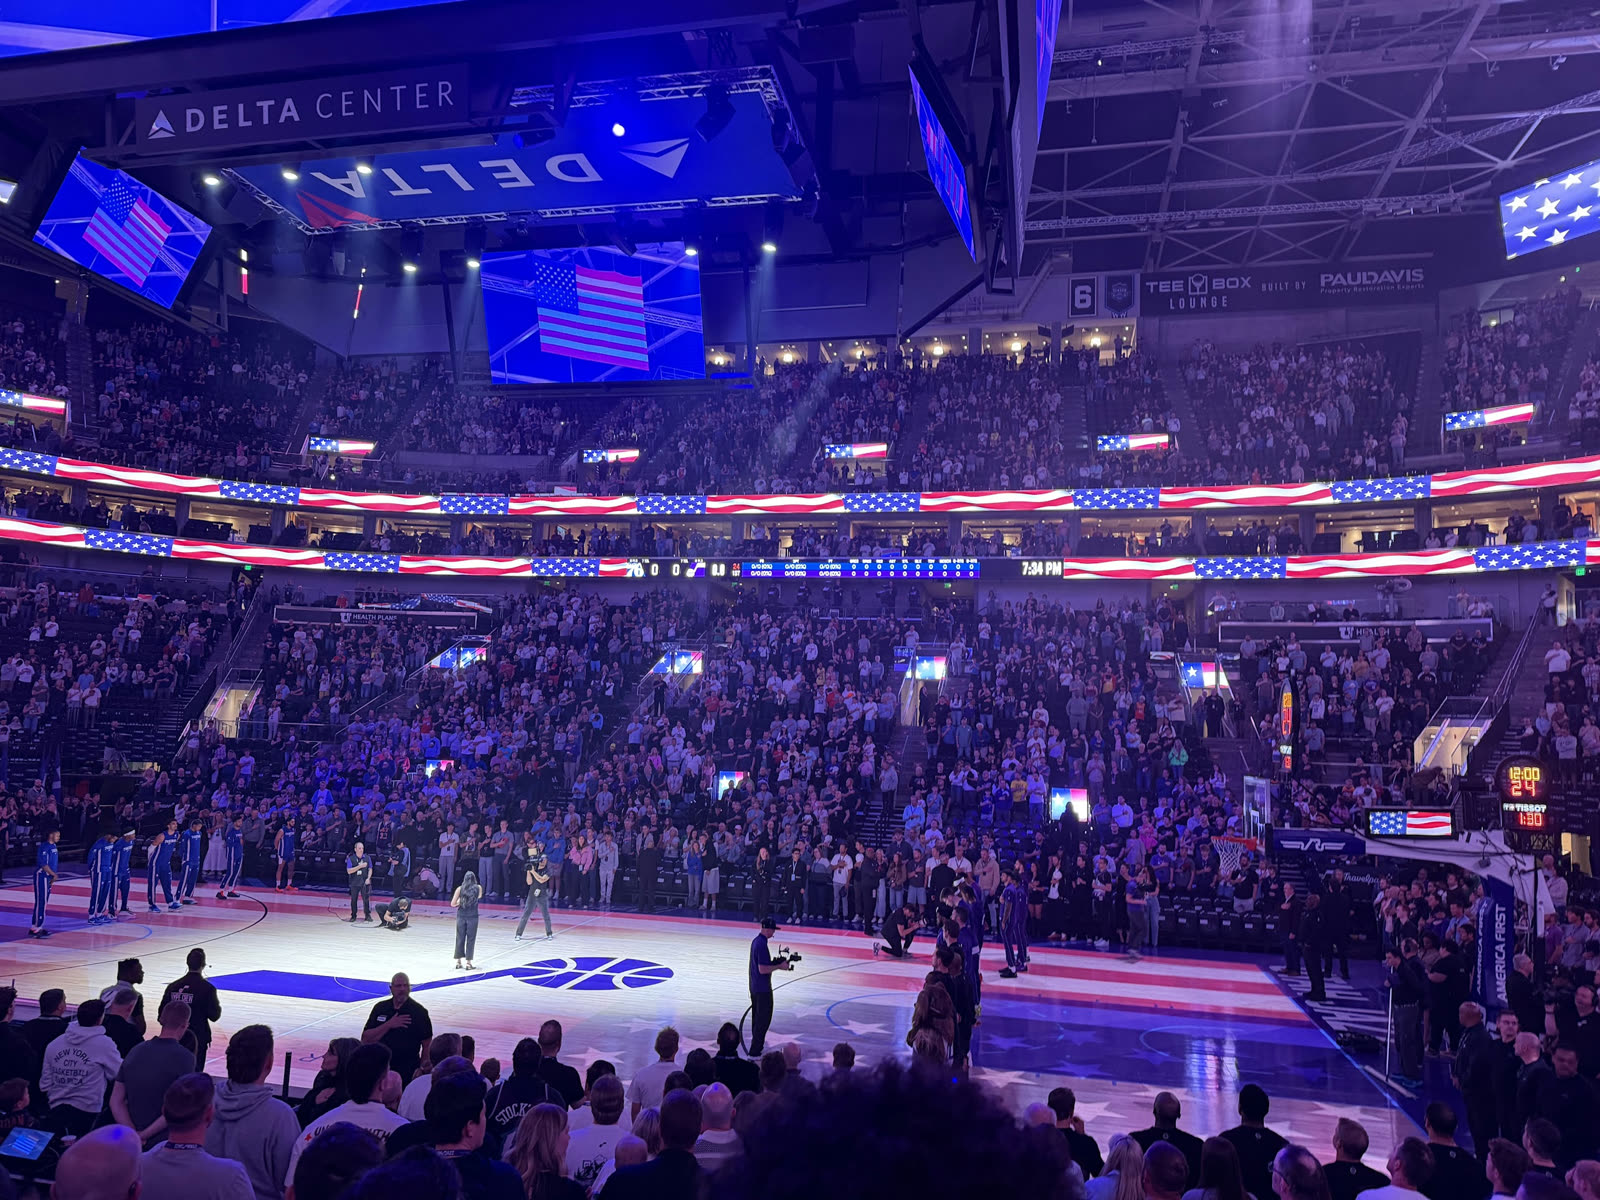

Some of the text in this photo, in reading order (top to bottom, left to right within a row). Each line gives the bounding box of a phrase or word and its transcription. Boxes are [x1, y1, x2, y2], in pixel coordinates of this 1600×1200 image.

[185, 80, 455, 133] DELTA CENTER
[310, 152, 604, 198] DELTA
[1145, 276, 1251, 293] TEE BOX
[1261, 280, 1306, 292] BUILT BY
[1074, 285, 1092, 309] 6
[1169, 295, 1228, 310] LOUNGE
[651, 563, 658, 576] 0
[672, 563, 680, 576] 0
[1022, 561, 1062, 576] 7:34 PM
[1356, 628, 1390, 636] HALH
[1509, 766, 1540, 781] 12:00
[1511, 780, 1536, 797] 24
[1515, 803, 1547, 812] TISSOT
[1519, 812, 1542, 826] 1:30
[1495, 904, 1508, 1004] AMERICA FIRST
[54, 1048, 90, 1064] NEW YORK
[64, 1059, 78, 1068] CITY
[495, 1103, 531, 1126] STOCK
